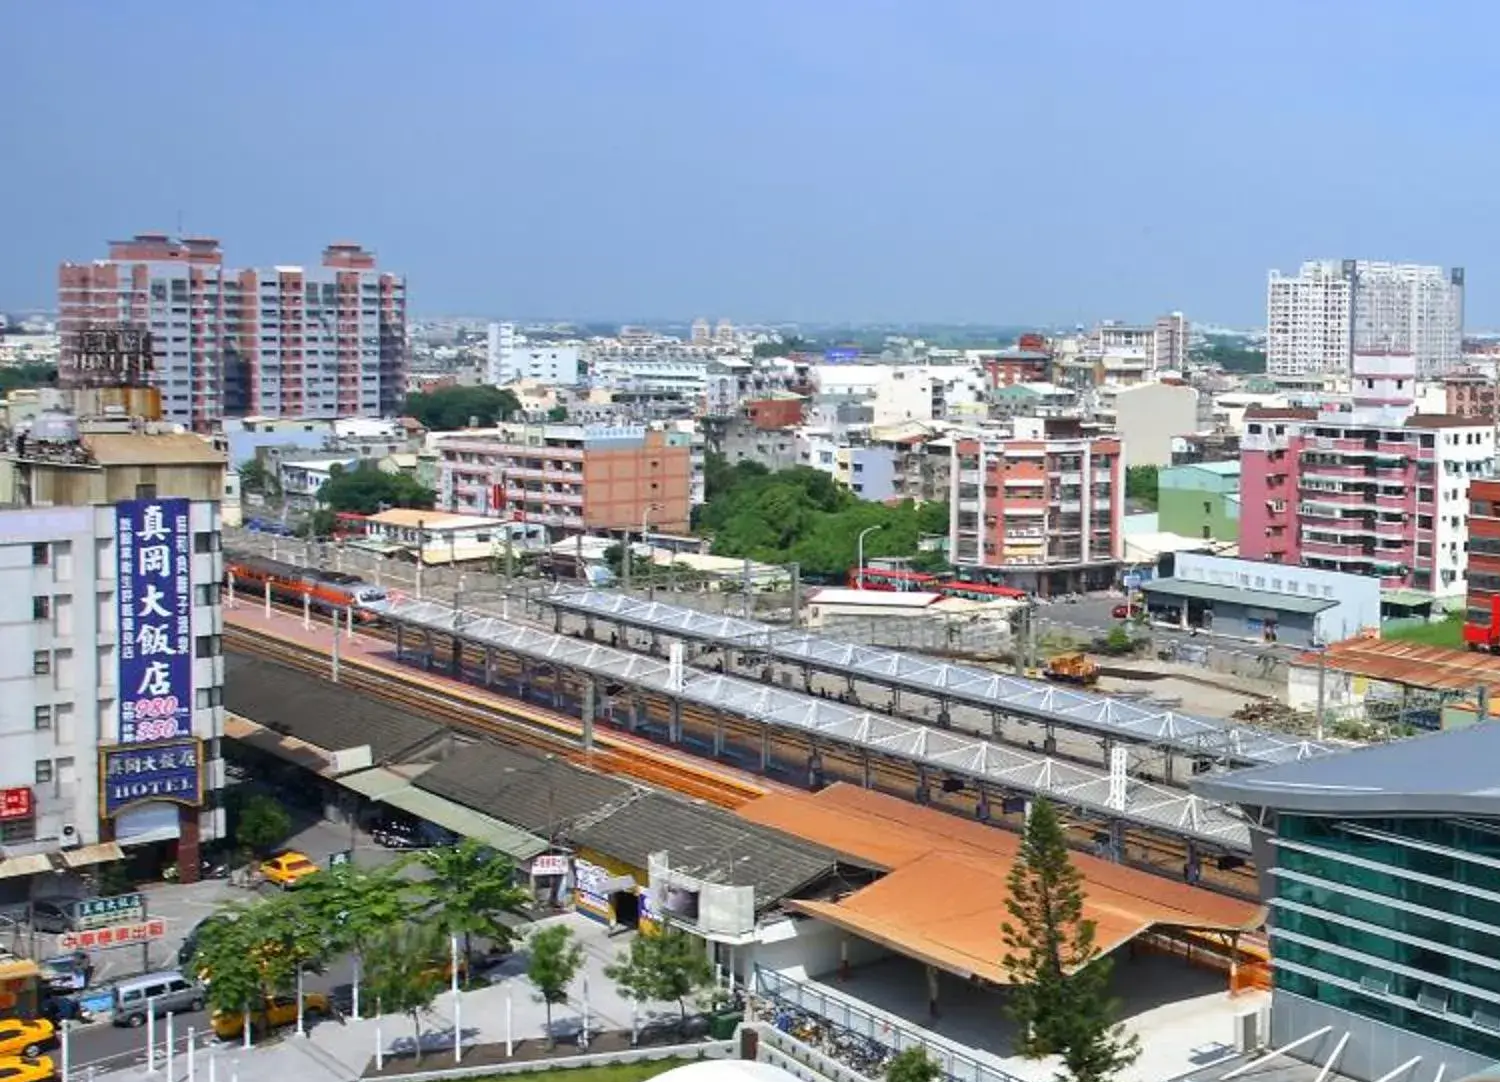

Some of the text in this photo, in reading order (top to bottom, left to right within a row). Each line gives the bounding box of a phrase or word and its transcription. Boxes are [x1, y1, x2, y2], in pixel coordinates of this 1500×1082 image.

[136, 504, 177, 695] 真岡大飯店
[108, 748, 197, 775] 真岡大飯店
[114, 778, 194, 799] HOTEL
